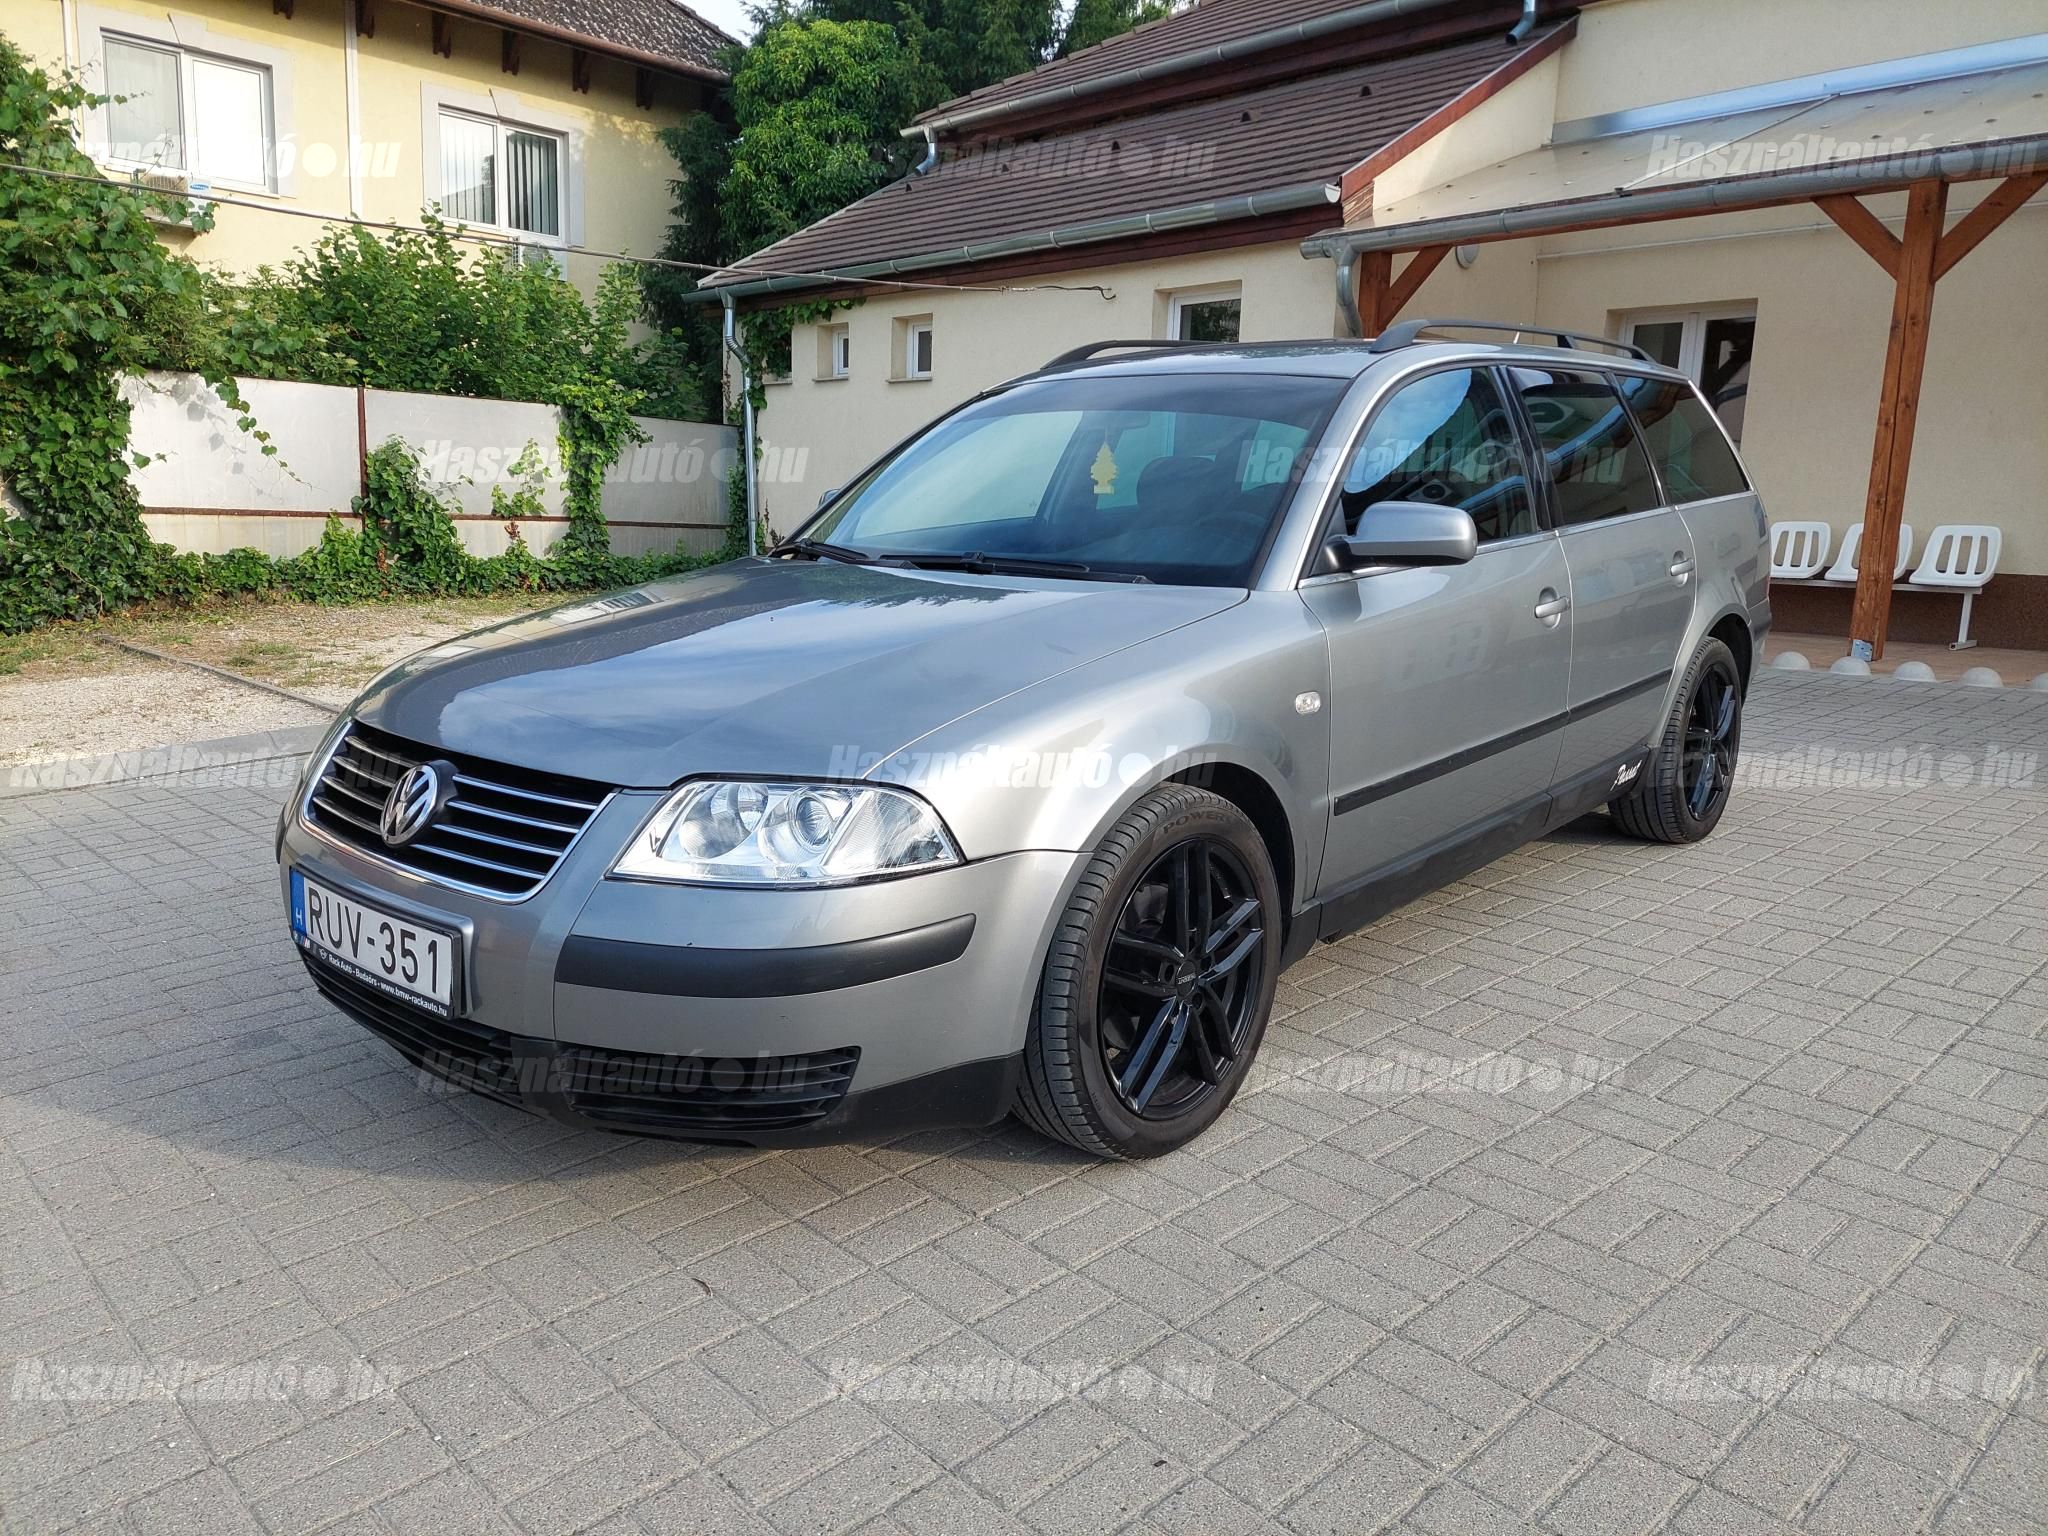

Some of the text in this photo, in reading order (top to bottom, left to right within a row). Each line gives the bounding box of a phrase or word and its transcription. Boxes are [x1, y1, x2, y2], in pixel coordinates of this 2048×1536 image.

[295, 906, 303, 926] H
[308, 886, 438, 994] RUV-351
[380, 981, 448, 1017] www.bmw-rackauto.hu
